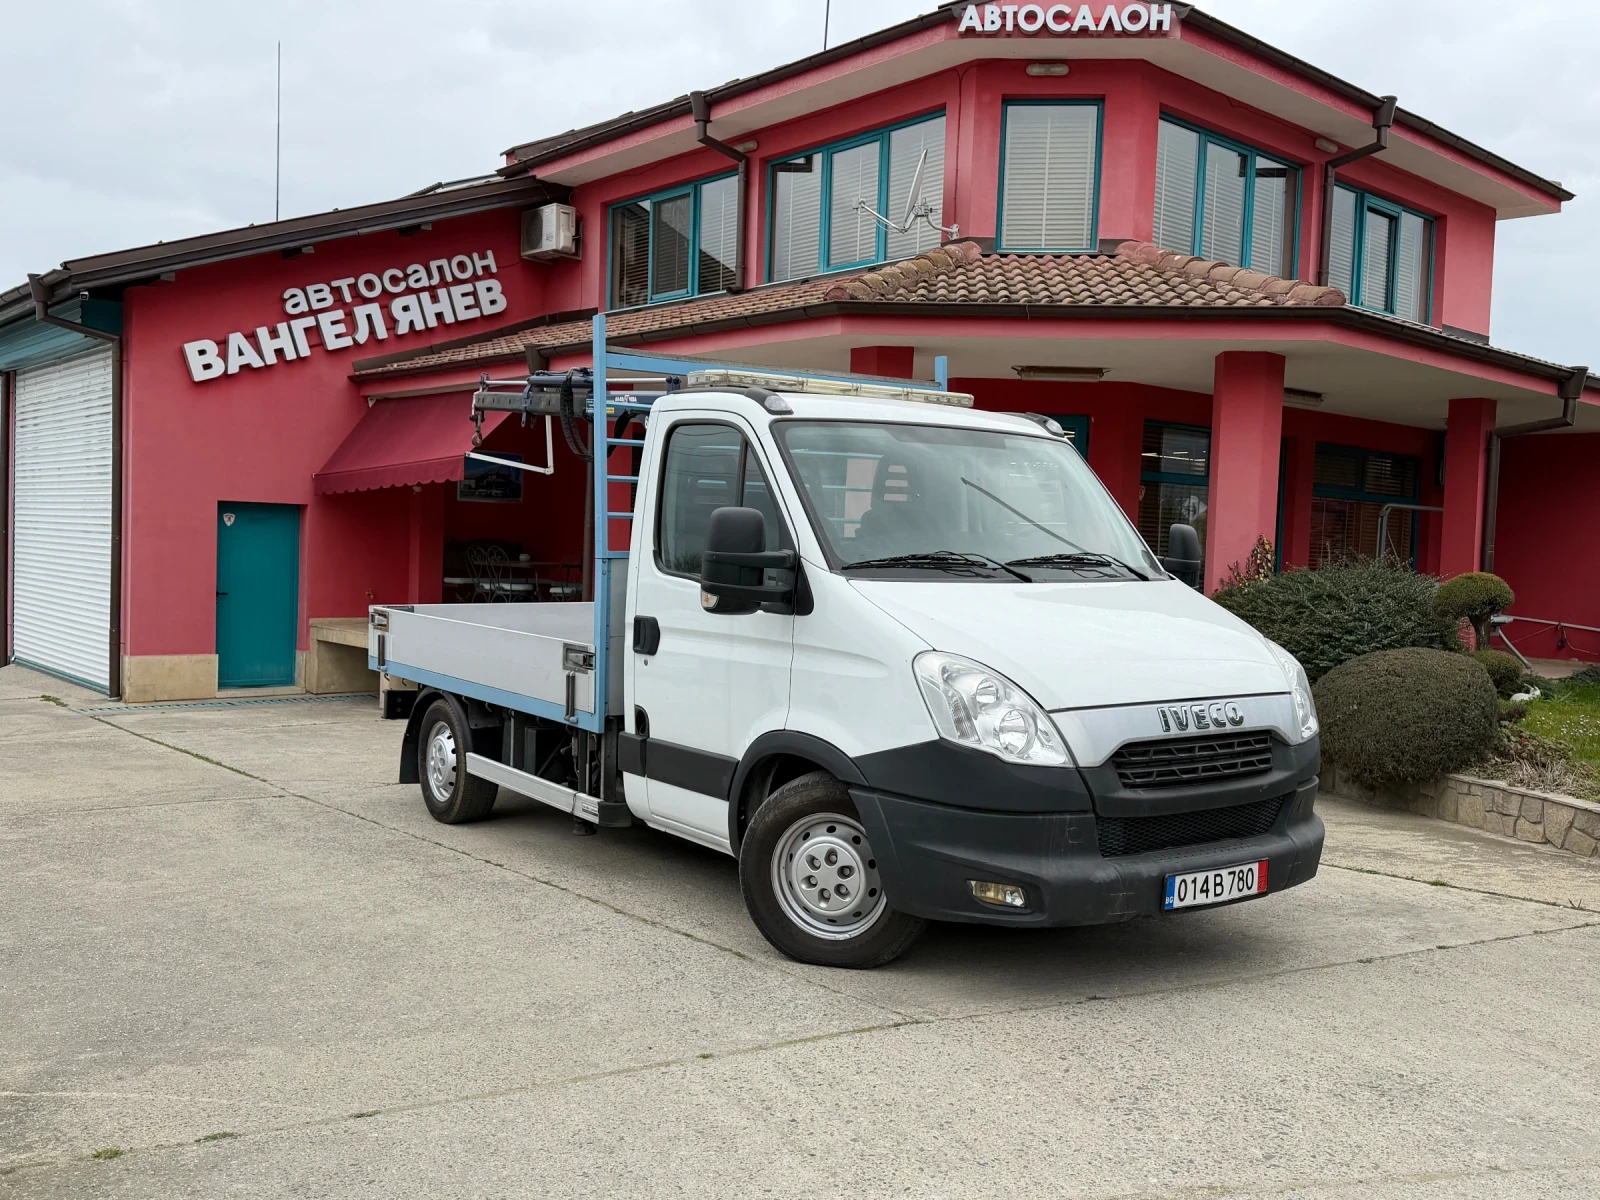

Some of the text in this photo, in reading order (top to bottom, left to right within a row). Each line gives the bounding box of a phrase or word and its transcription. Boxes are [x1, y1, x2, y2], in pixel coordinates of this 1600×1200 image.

[958, 4, 1171, 34] АВТОСАЛОН
[282, 249, 498, 315] автосалон
[182, 278, 508, 383] ВАНГЕЛ ЯНЕВ
[1157, 701, 1245, 733] IVECO
